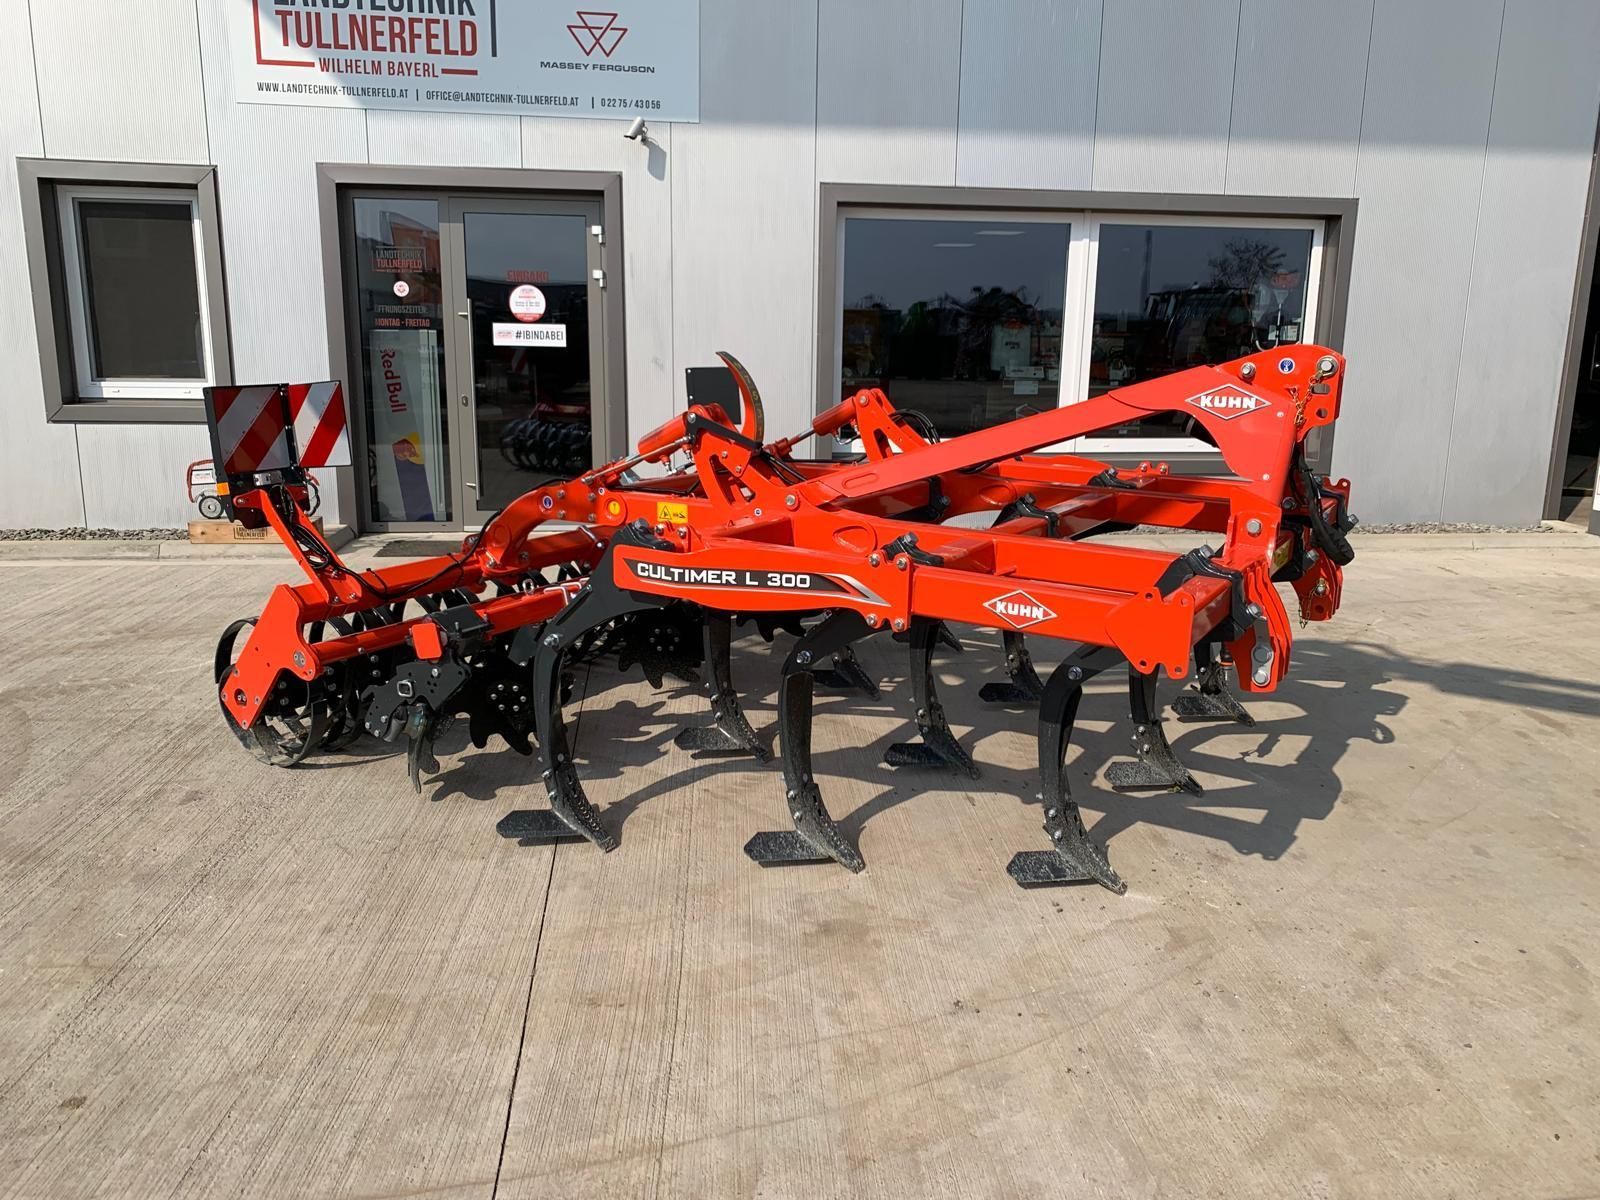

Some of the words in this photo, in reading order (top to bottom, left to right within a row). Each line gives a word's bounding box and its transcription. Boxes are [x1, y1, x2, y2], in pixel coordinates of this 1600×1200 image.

[275, 9, 478, 57] TULLNERFELD
[318, 57, 382, 75] WILHELM
[387, 61, 439, 78] BAYERL
[540, 61, 589, 70] MASSEY
[592, 64, 655, 73] FERGUSON
[256, 81, 409, 99] WWW.LANDTECHNIK-TULLNERFELD.AT
[426, 90, 579, 107] OFFICE@LANDTECHNIK-TULLNERFELD.AT
[515, 329, 564, 341] #IBINDABEI
[387, 382, 407, 413] Bull
[1200, 395, 1256, 409] KUHN
[637, 563, 737, 585] CULTIMER
[745, 572, 758, 586] L
[767, 573, 811, 588] 300
[995, 600, 1044, 619] KUHN
